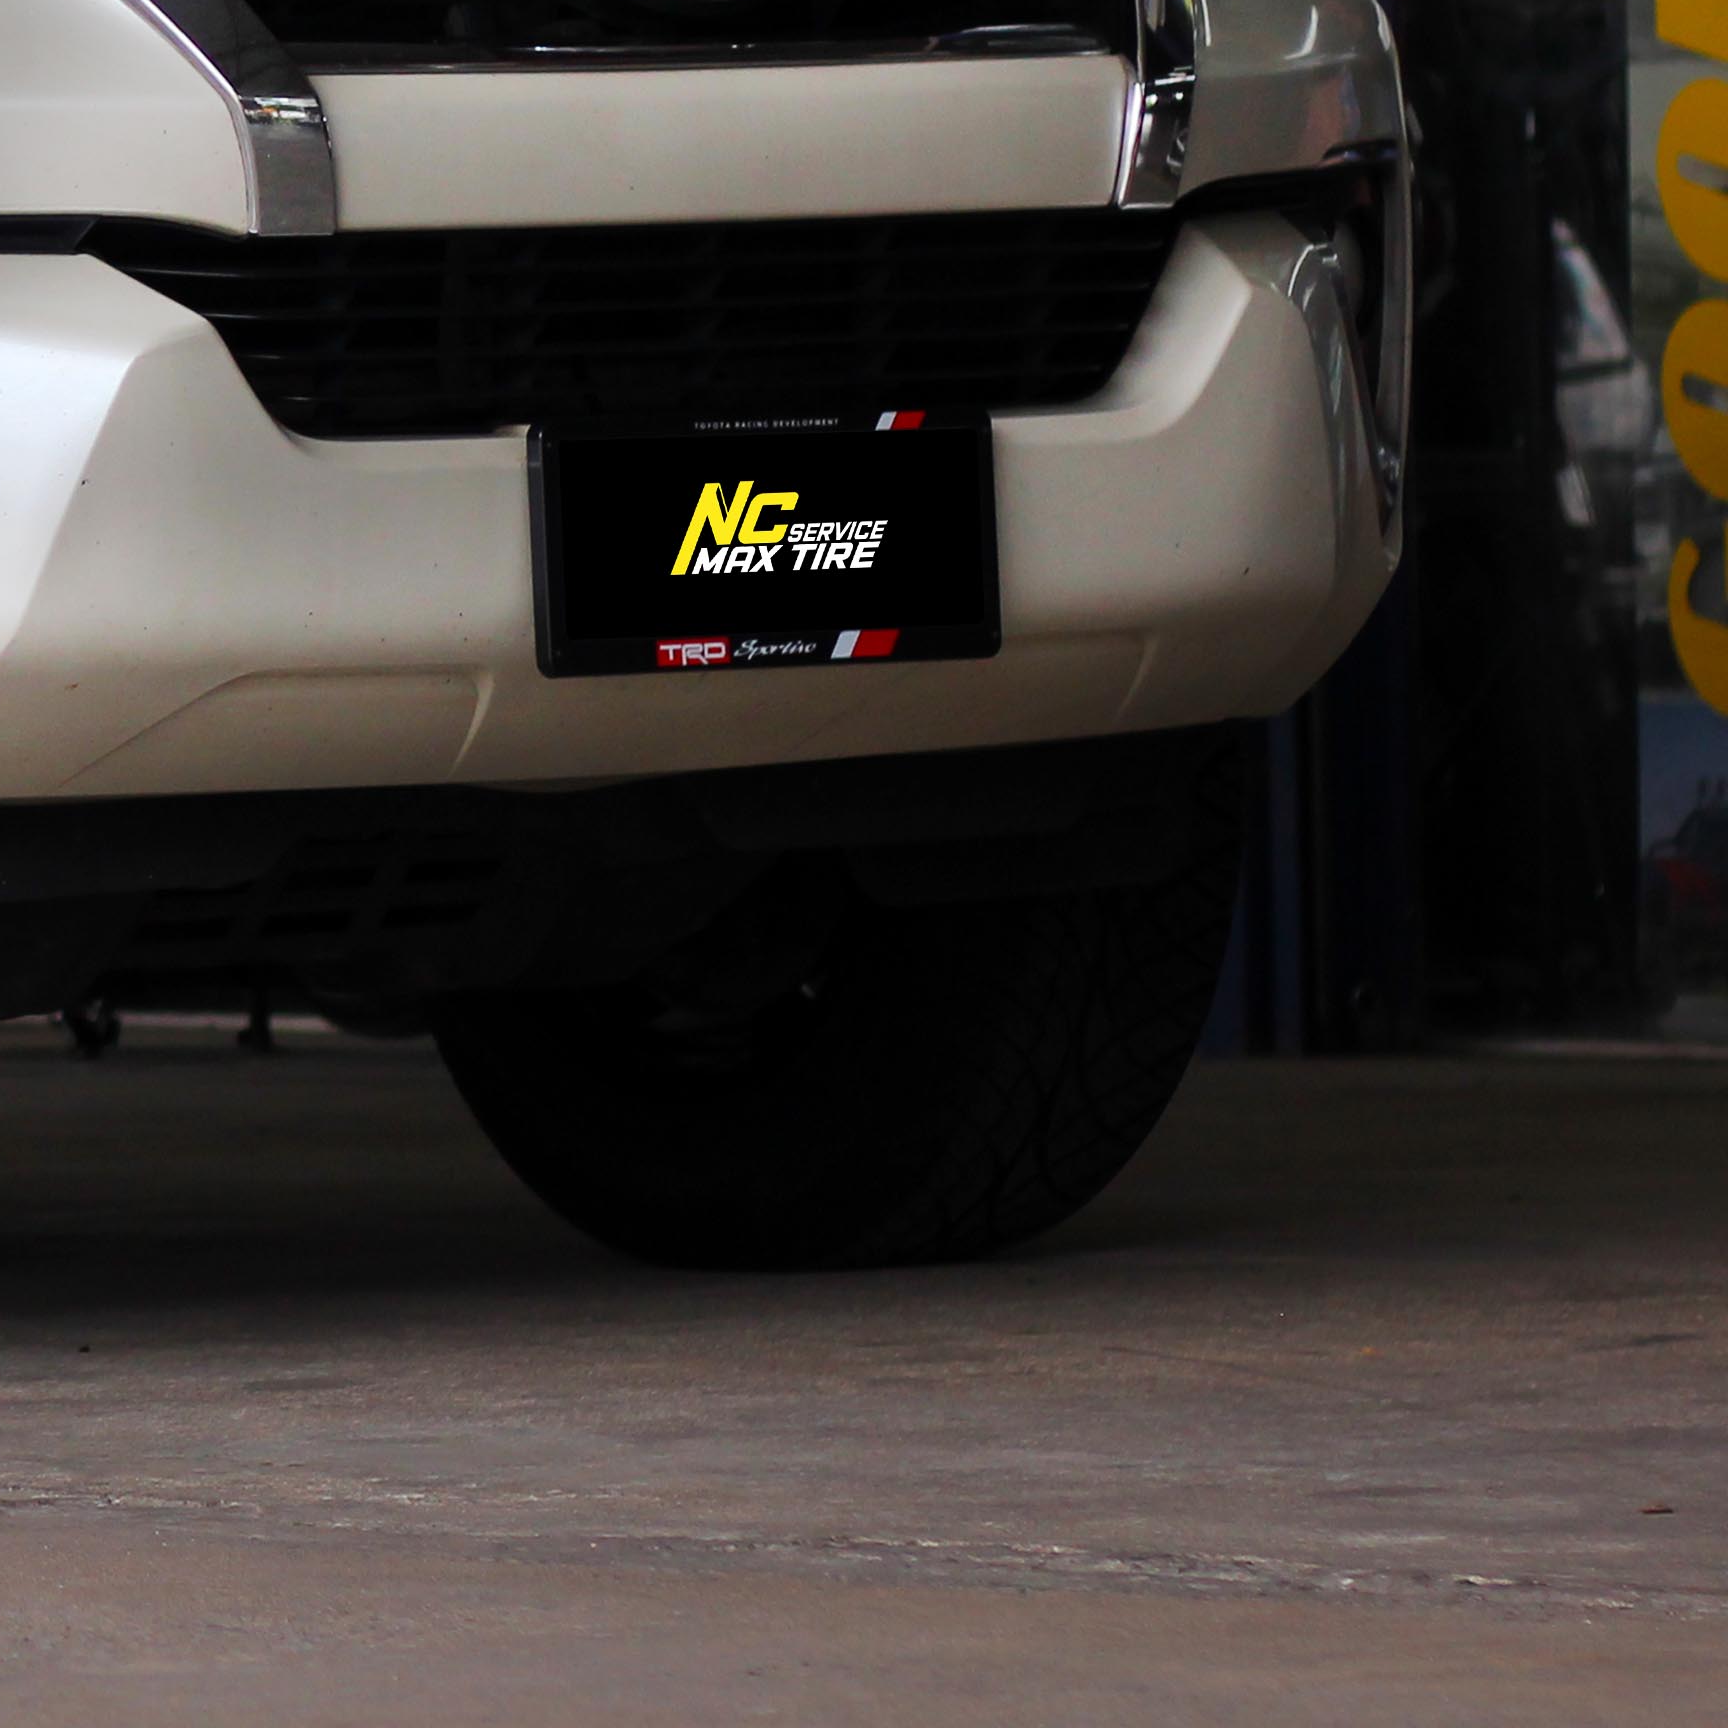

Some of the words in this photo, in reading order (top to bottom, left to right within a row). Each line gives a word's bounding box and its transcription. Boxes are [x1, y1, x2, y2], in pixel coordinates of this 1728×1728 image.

[694, 421, 732, 430] TOYOTA
[735, 420, 769, 429] RACING
[773, 418, 840, 428] DEVELOPMENT
[659, 640, 726, 666] TRD
